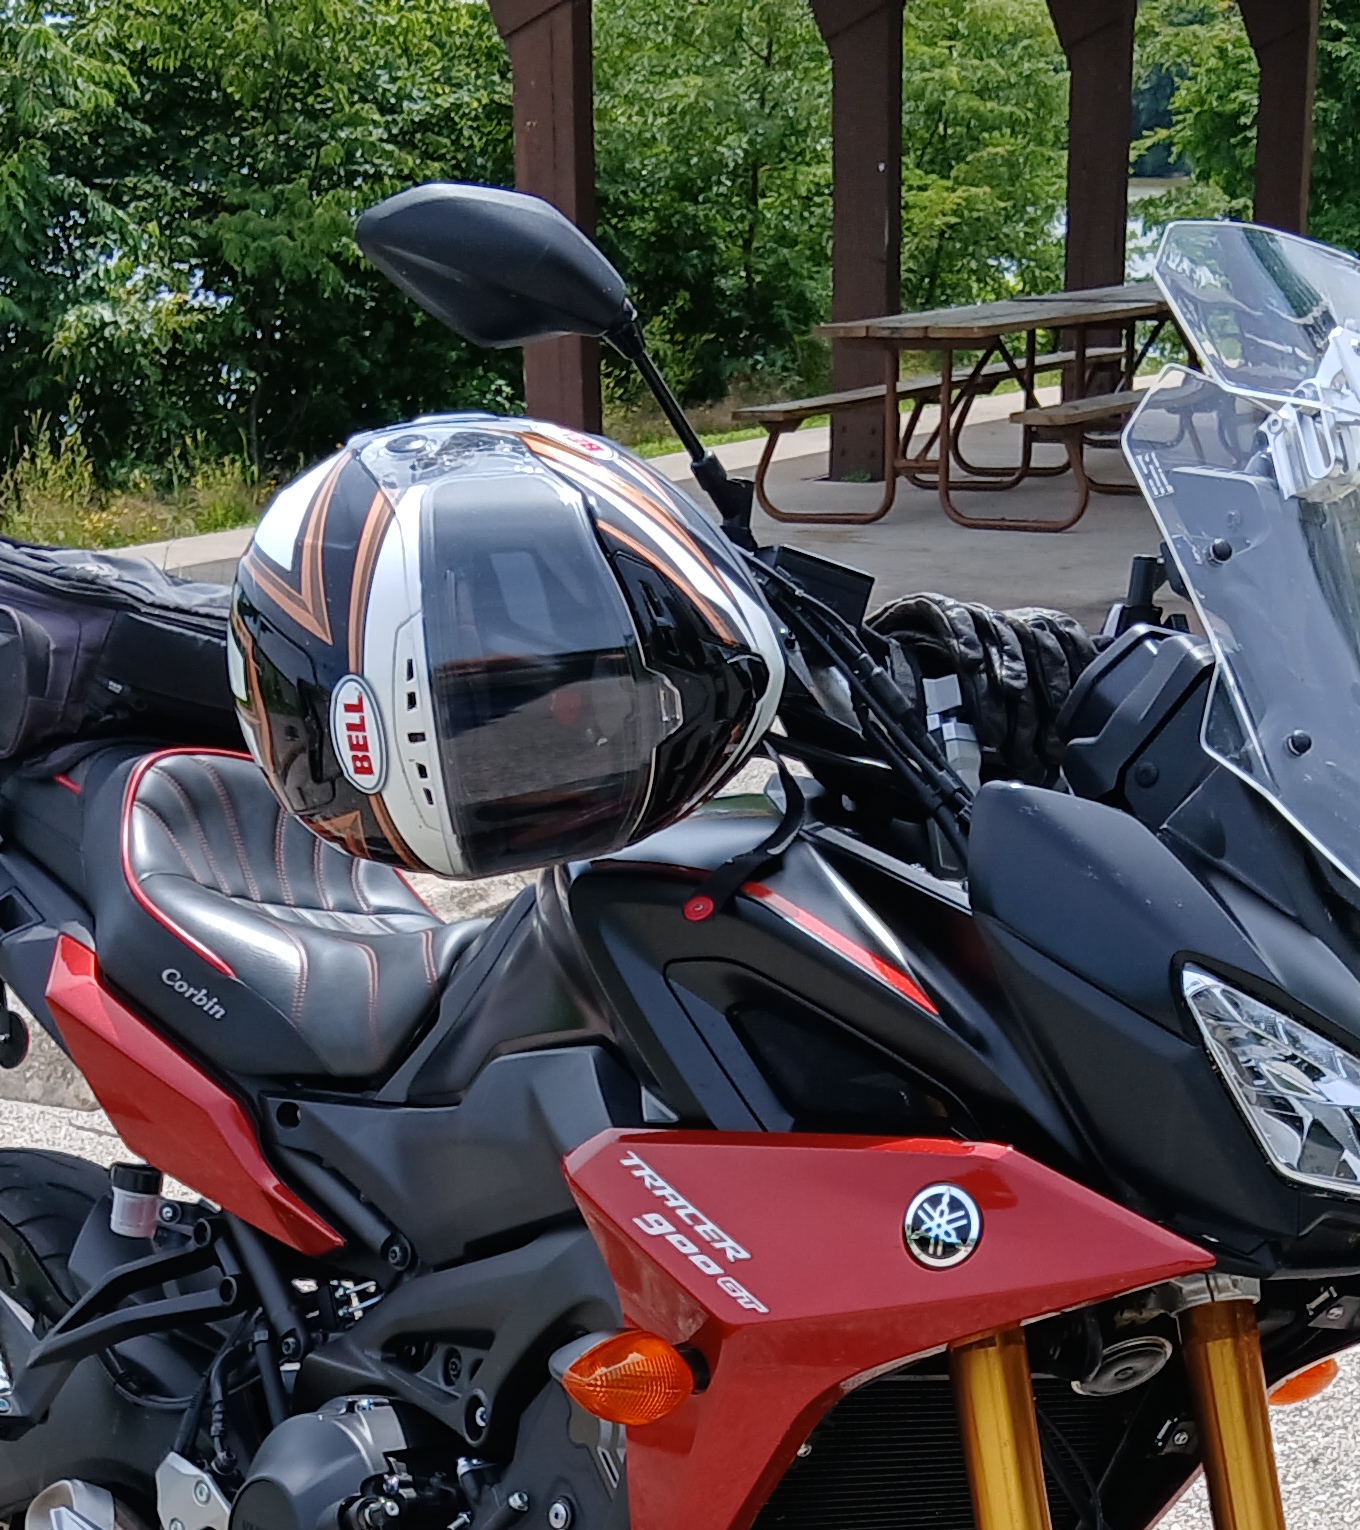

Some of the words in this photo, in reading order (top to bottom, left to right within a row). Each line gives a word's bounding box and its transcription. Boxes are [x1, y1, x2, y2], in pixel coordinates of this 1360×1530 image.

[343, 694, 375, 776] BELL
[161, 968, 226, 1019] Corbin
[619, 1150, 752, 1263] TRACER
[632, 1212, 725, 1275] 900
[716, 1276, 770, 1314] GT
